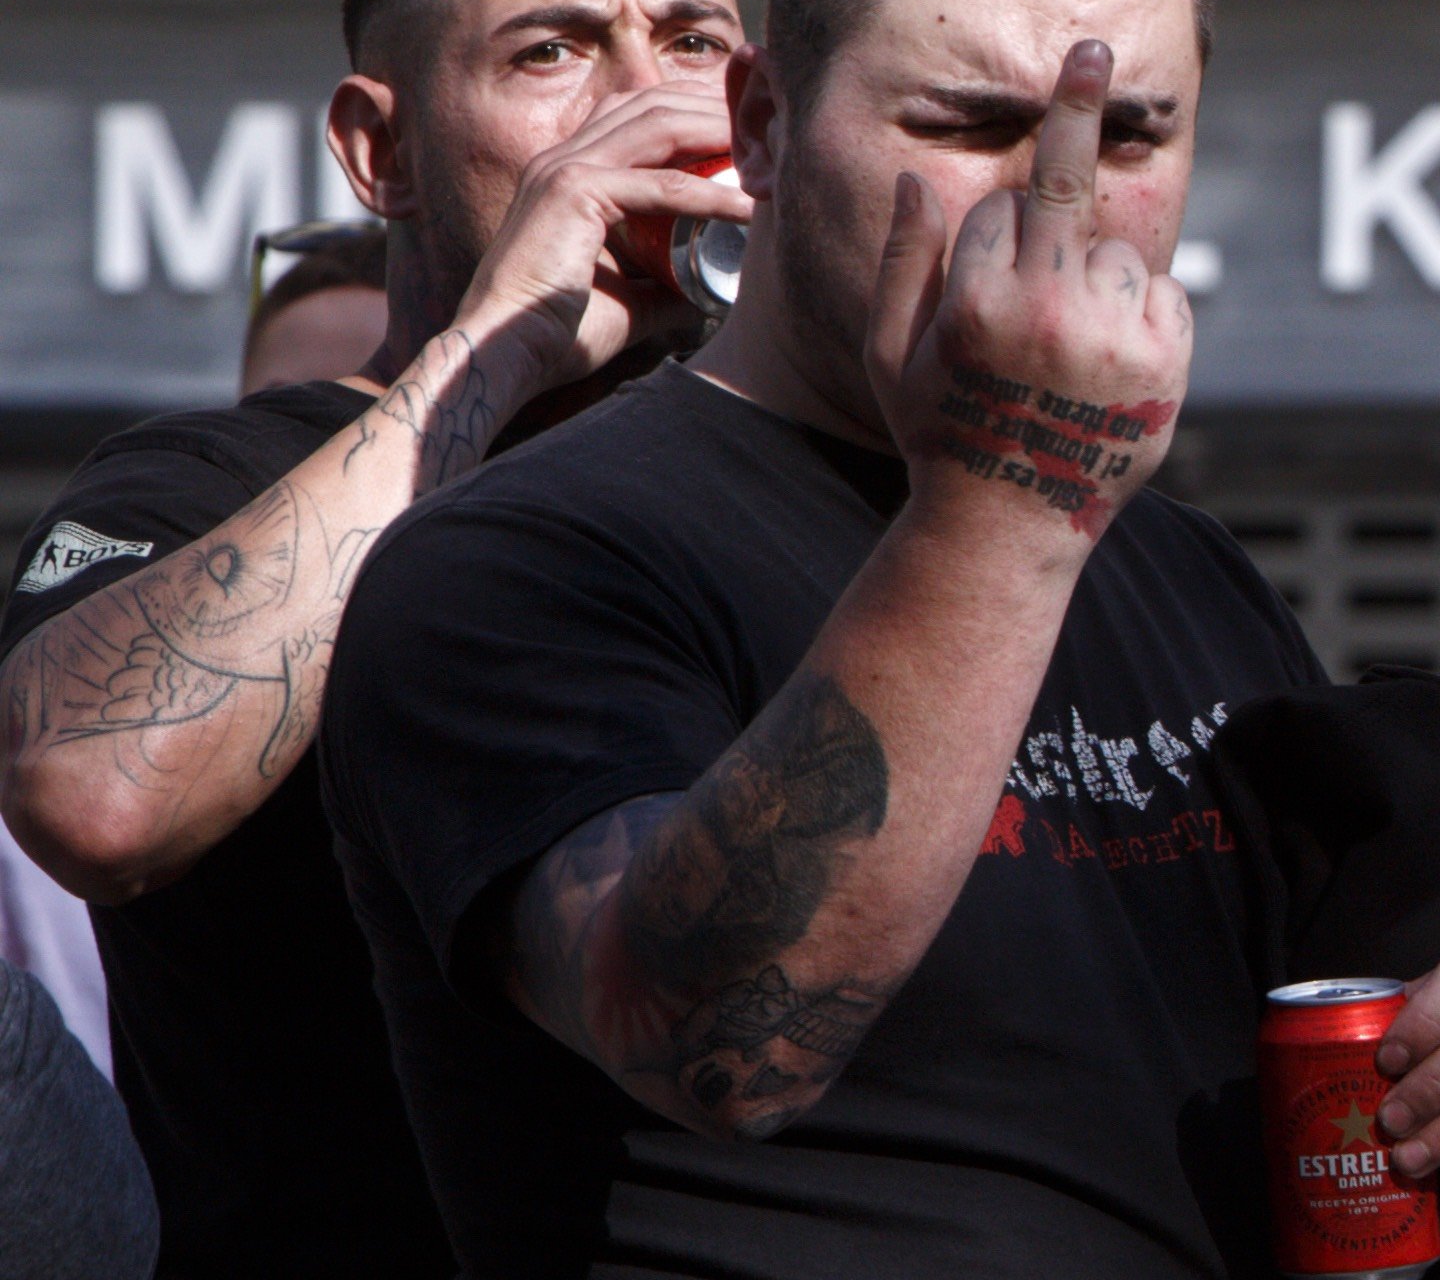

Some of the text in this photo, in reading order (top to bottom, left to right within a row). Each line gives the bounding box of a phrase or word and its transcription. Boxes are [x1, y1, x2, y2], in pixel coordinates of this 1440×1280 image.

[62, 542, 148, 568] BOYS
[1297, 1149, 1390, 1179] ESTREL
[1338, 1174, 1384, 1190] DAMM
